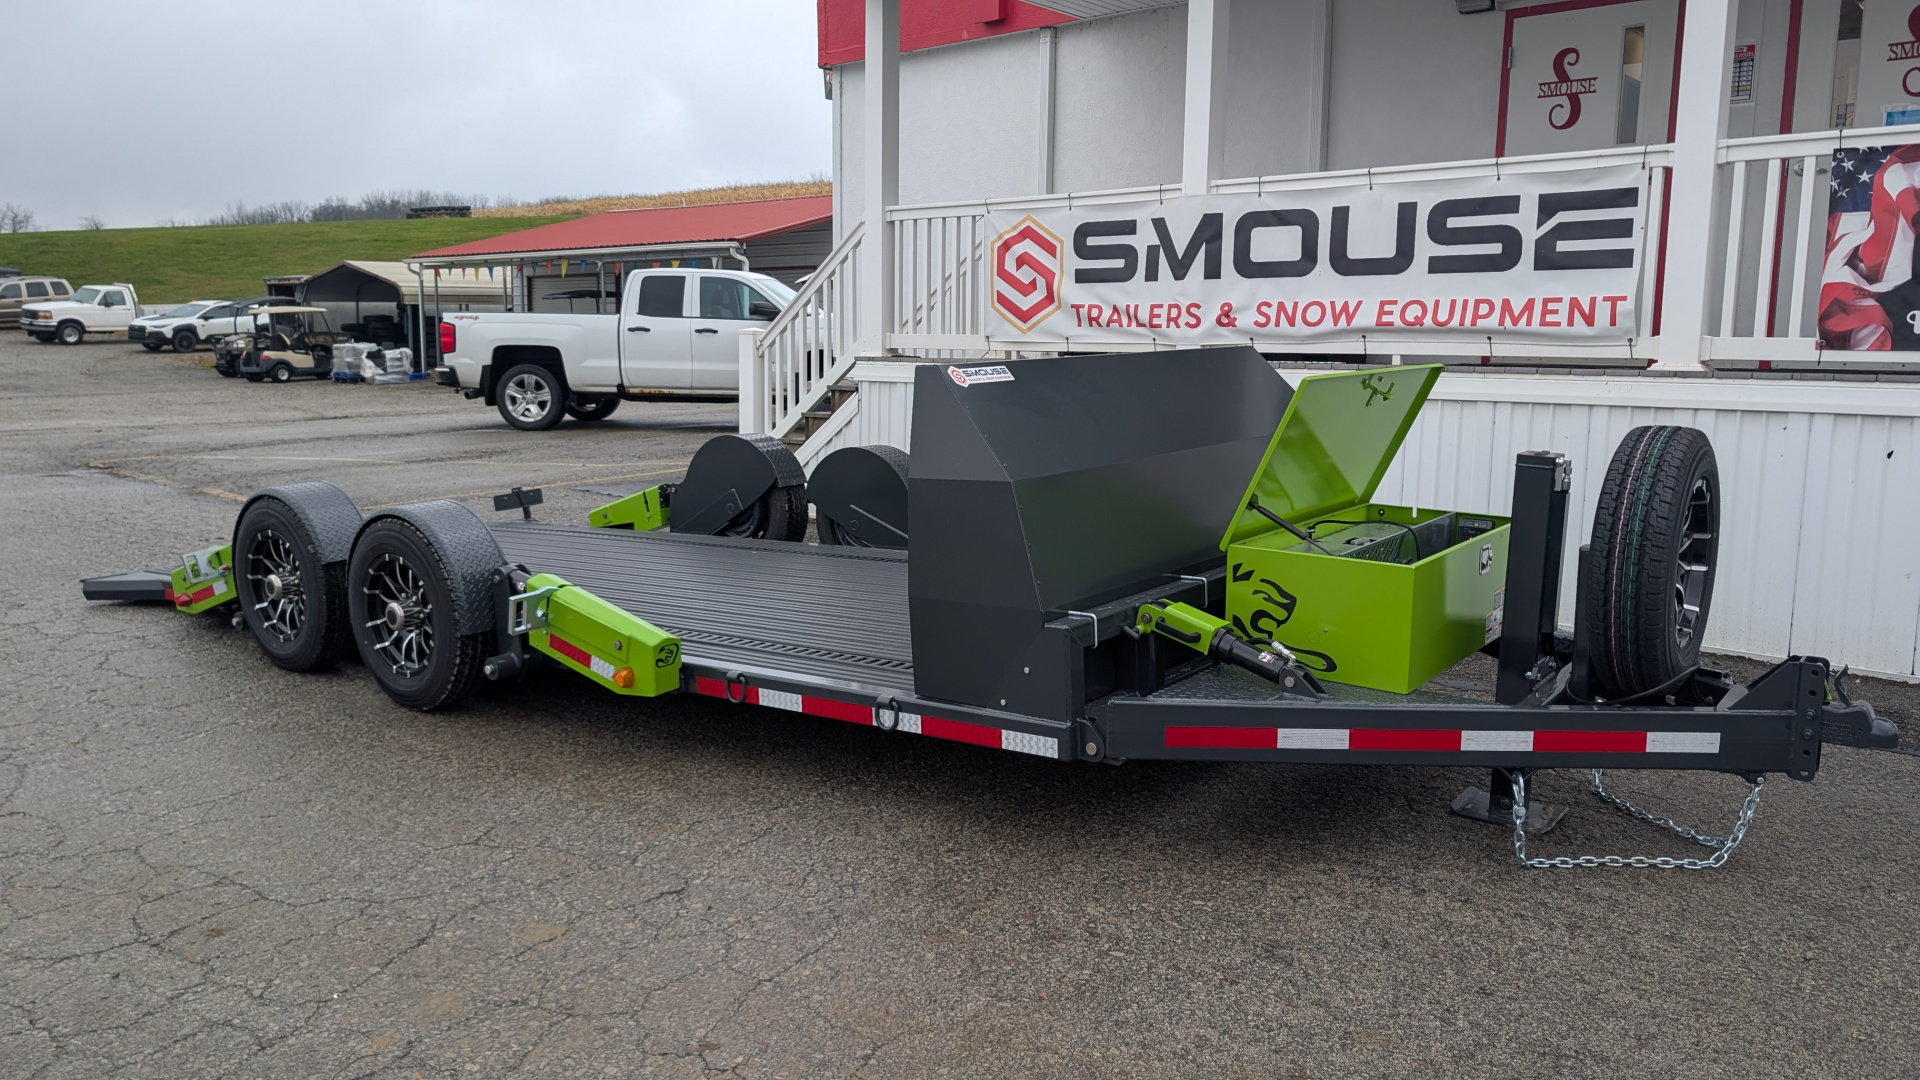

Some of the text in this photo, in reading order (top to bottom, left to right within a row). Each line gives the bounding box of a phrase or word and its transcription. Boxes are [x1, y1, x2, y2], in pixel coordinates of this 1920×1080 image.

[1538, 79, 1597, 97] SMOUSE
[1073, 187, 1639, 284] SMOUSE
[1070, 295, 1628, 329] TRAILERS & SNOW EQUIPMENT
[962, 367, 1009, 377] SMOUSE
